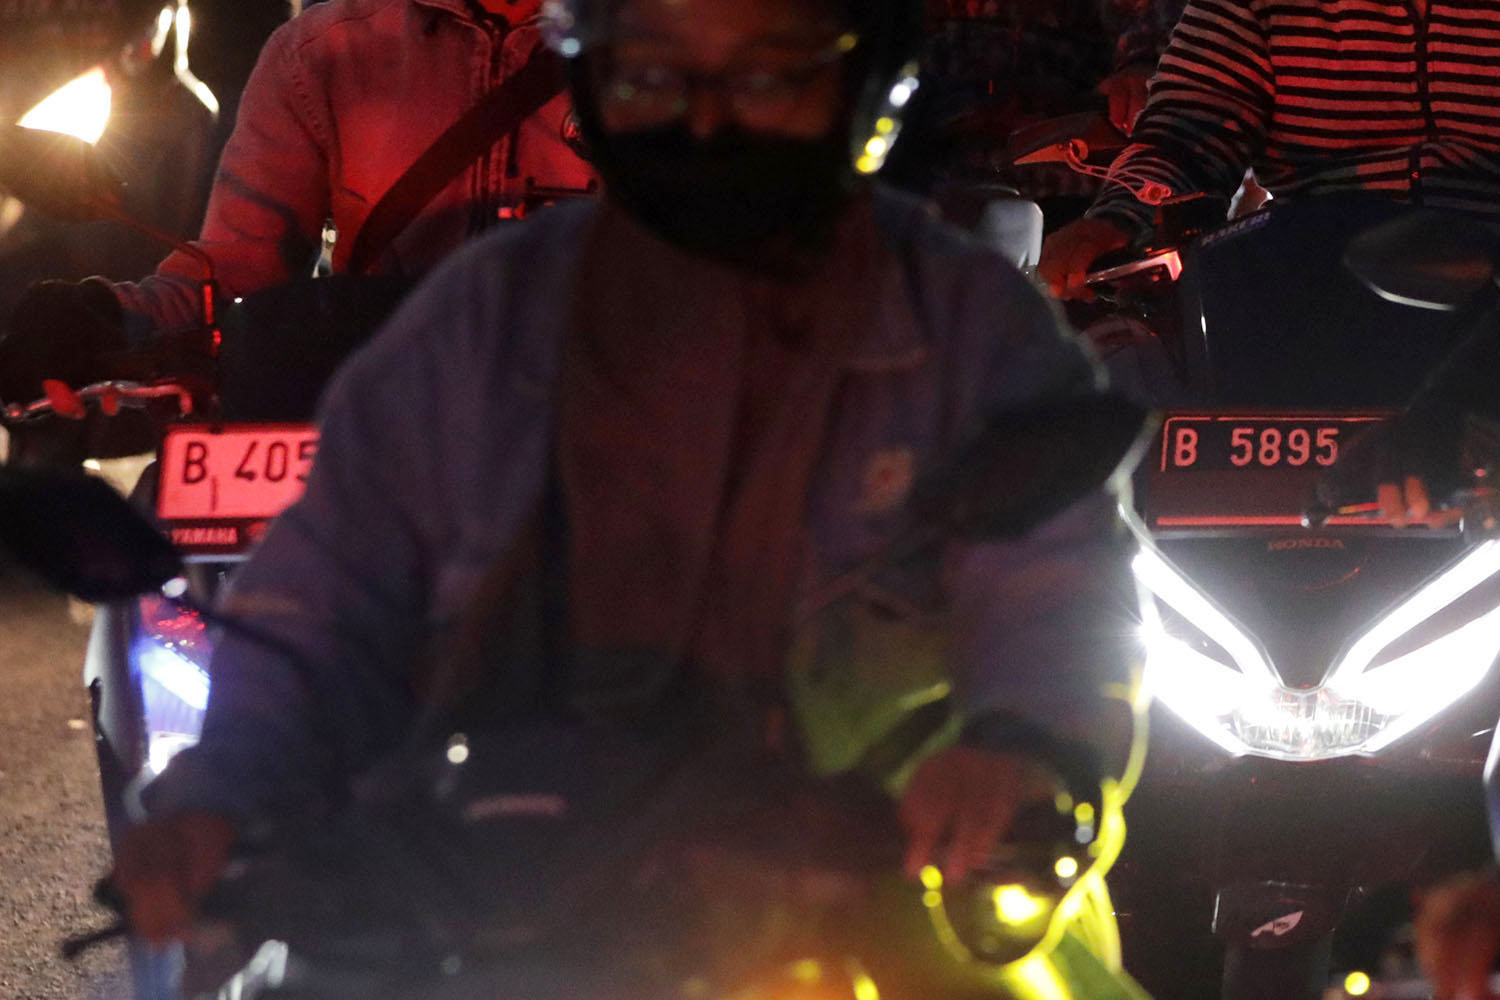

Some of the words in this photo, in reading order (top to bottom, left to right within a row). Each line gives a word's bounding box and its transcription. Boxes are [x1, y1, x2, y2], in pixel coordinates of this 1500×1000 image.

[183, 441, 207, 483] B
[1174, 427, 1199, 467] B
[1229, 427, 1341, 467] 5895
[1267, 537, 1345, 551] HONDA
